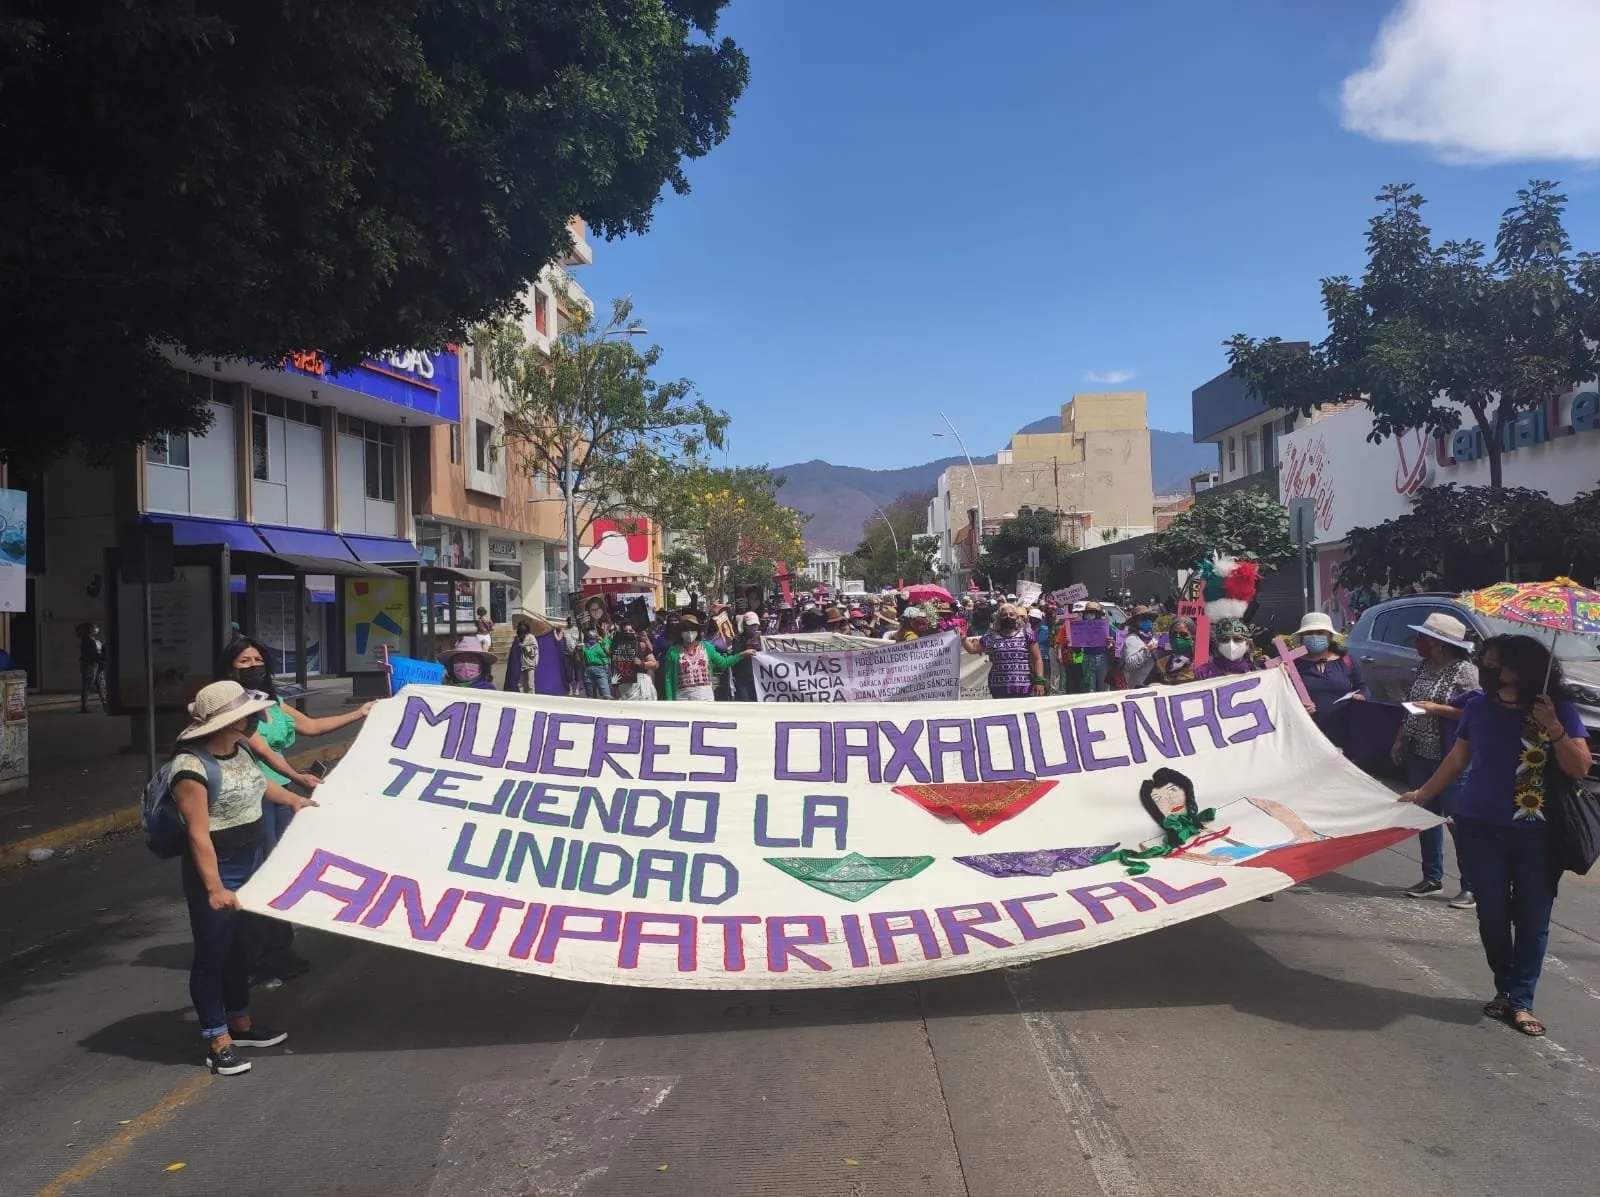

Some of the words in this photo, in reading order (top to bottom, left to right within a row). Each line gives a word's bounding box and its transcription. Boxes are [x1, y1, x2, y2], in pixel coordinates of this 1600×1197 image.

[919, 638, 944, 649] VICARIA
[759, 662, 790, 679] NO
[794, 655, 842, 677] MÁS
[855, 656, 873, 667] FIDEL
[874, 652, 909, 665] GALLEGOS
[760, 676, 845, 693] VIOLENCIA
[855, 690, 876, 701] JOANA
[878, 681, 926, 697] VASCONCELOS
[926, 676, 959, 689] SÁNCHEZ
[391, 697, 738, 782] MUJERES
[774, 677, 1276, 784] OAXAQUEÑAS
[382, 758, 720, 843] TEJIENDO
[754, 794, 849, 850] LA
[447, 822, 739, 905] UNIDAD
[268, 848, 1228, 972] ANTIPATRIARCAL
